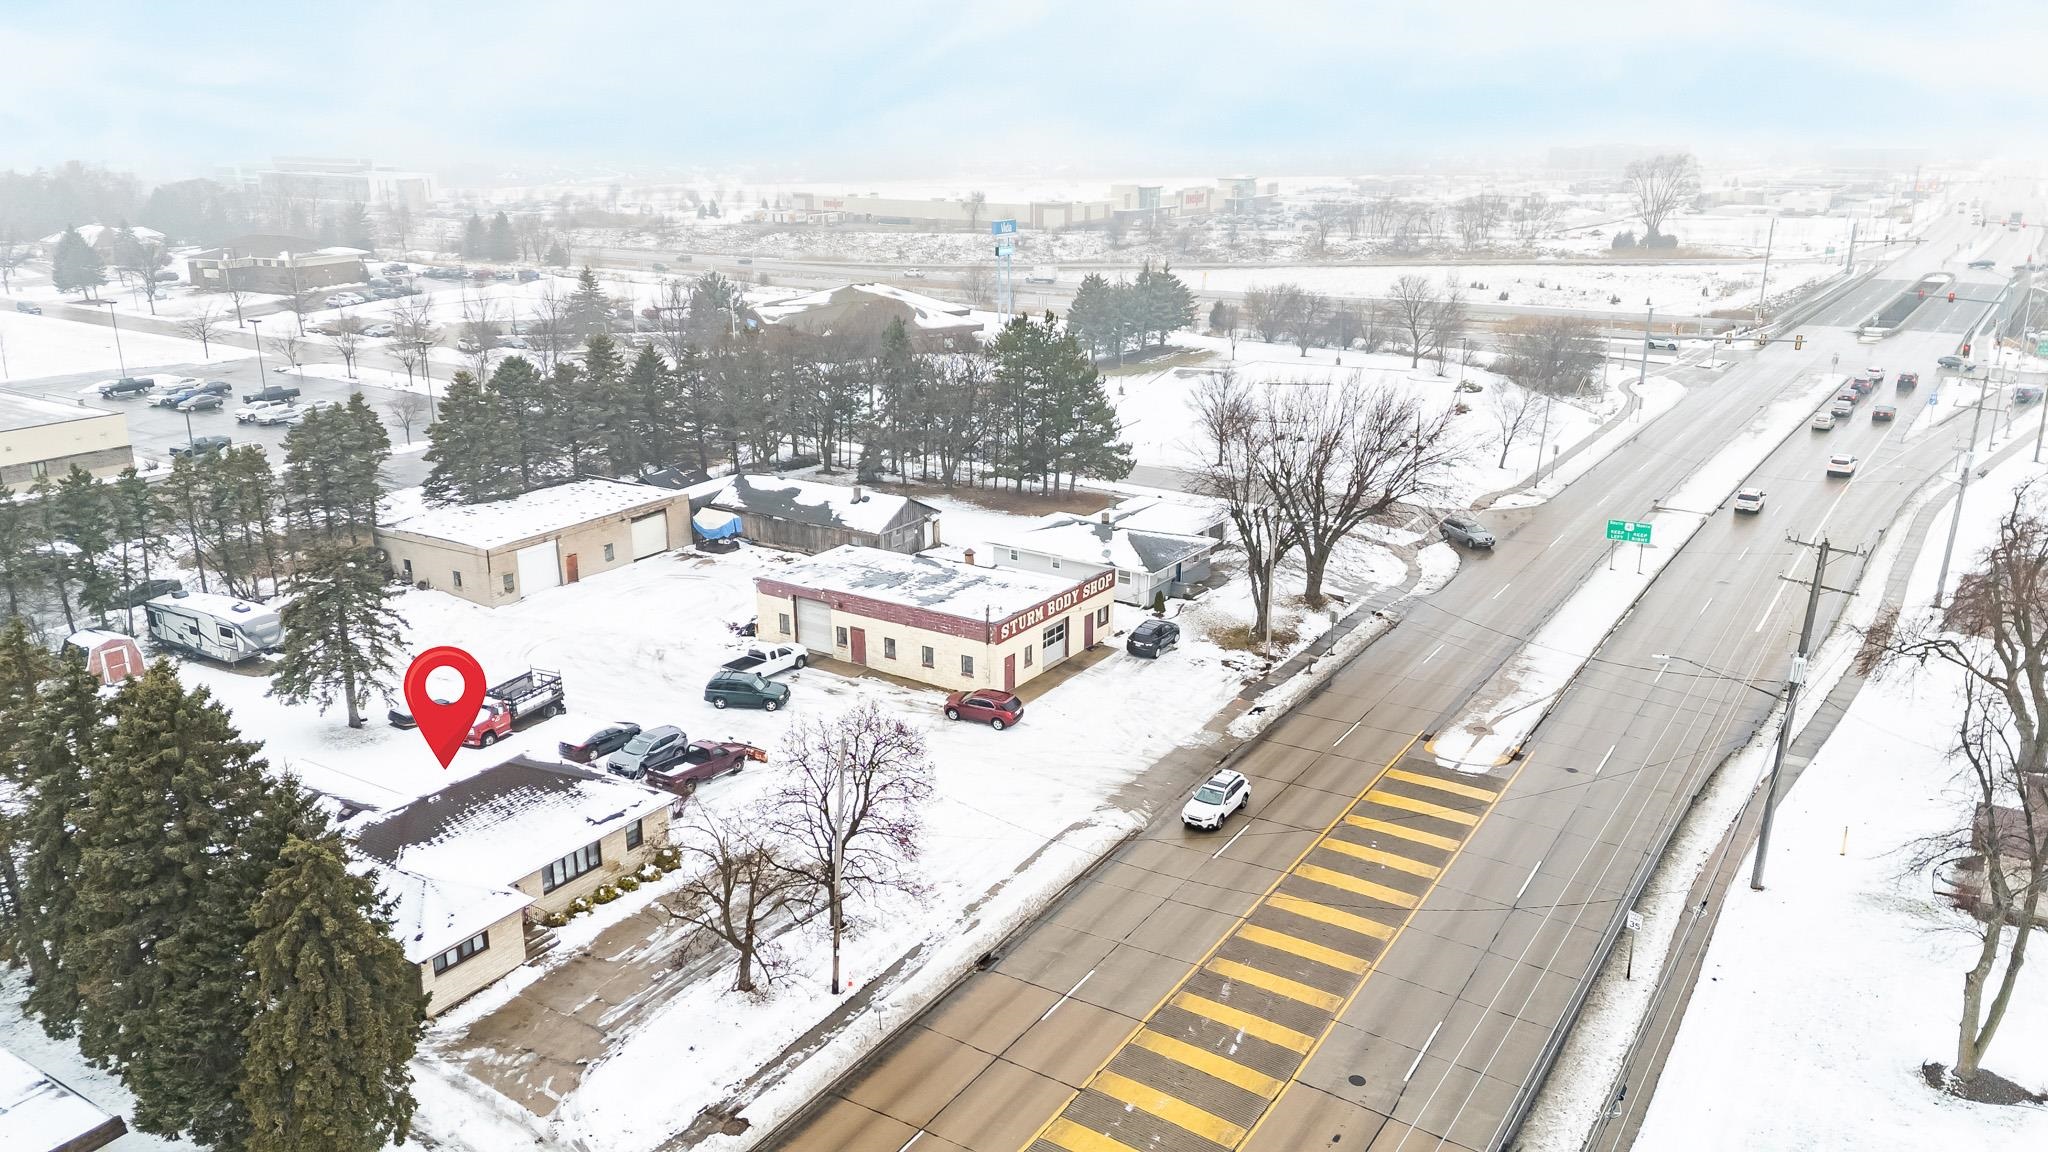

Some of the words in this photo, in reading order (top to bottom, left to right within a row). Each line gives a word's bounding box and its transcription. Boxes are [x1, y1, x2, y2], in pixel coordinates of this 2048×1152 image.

[1001, 606, 1044, 640] STURM
[1047, 589, 1080, 616] BODY
[1082, 573, 1113, 599] SHOP
[1630, 920, 1640, 930] 35
